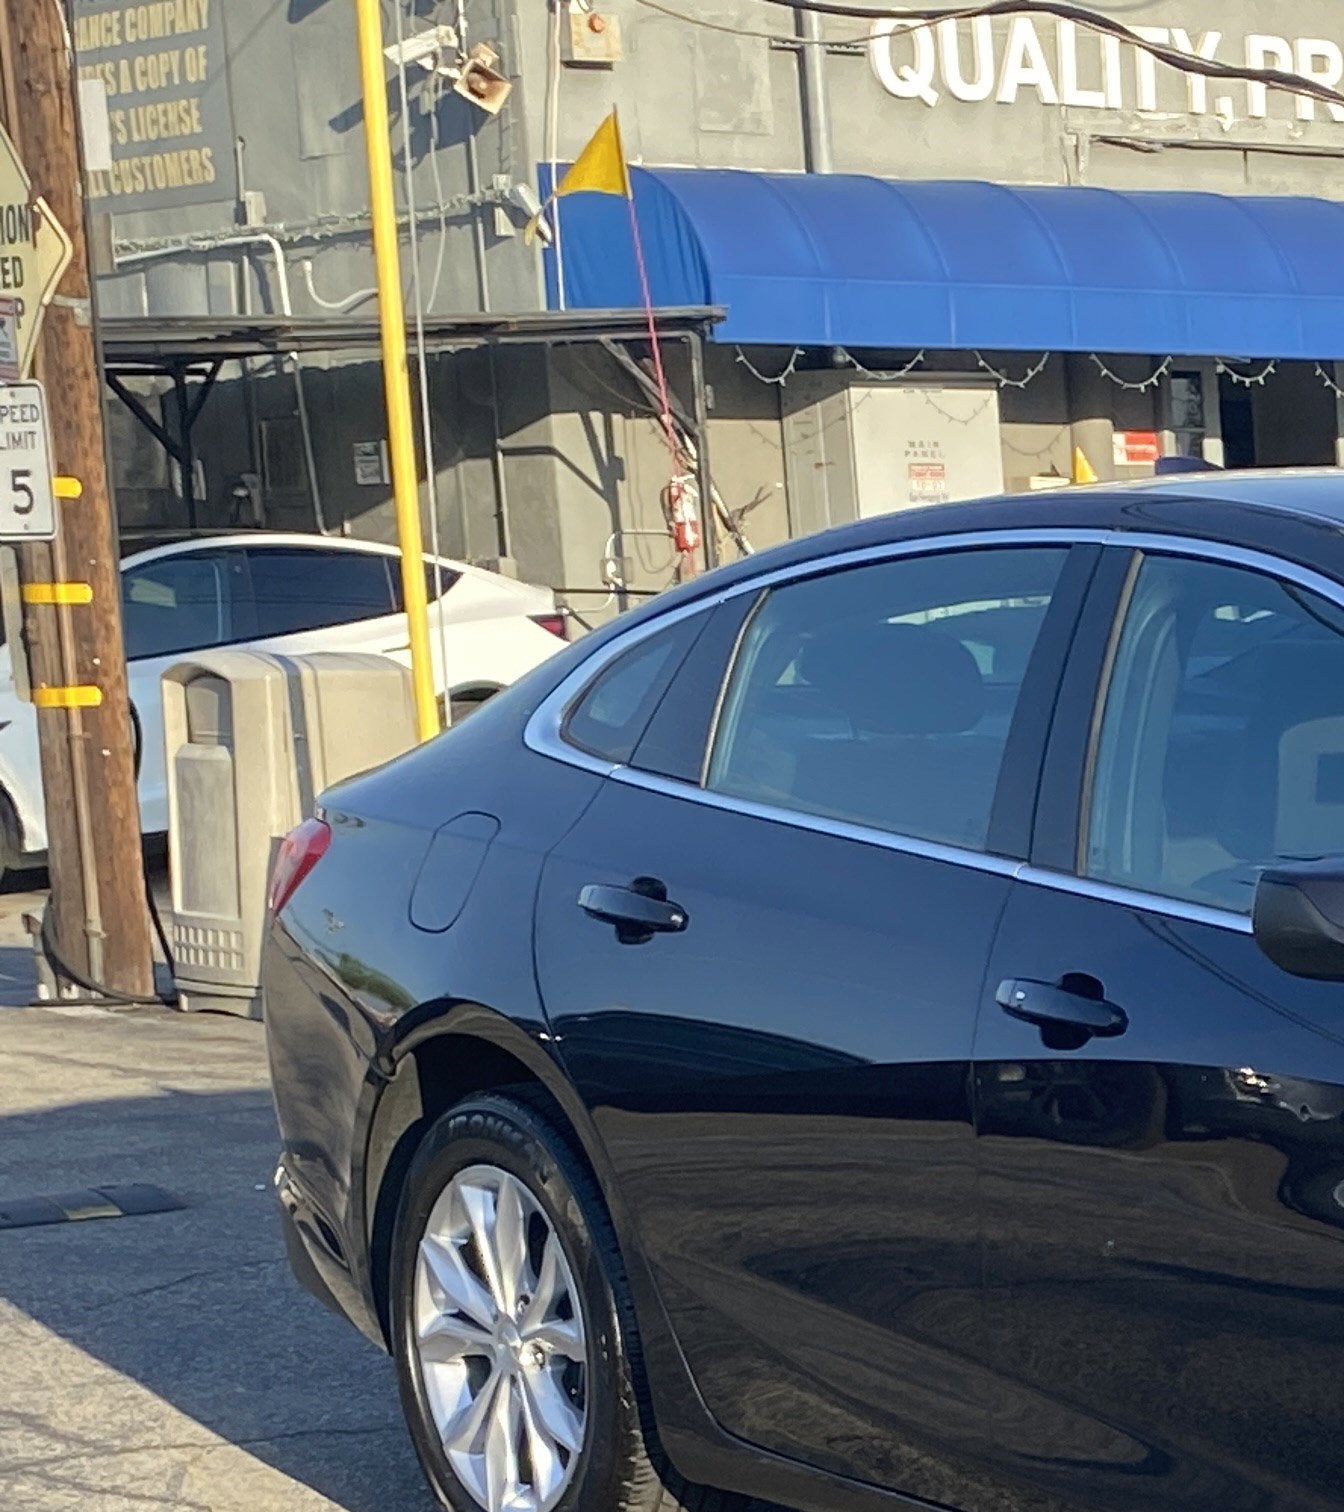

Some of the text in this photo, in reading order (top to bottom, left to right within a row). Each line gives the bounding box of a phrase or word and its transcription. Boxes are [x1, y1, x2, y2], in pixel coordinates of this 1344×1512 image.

[125, 0, 209, 43] COMPANY
[118, 59, 133, 94] A
[134, 51, 180, 92] COPY
[184, 44, 207, 83] OF
[130, 98, 203, 142] LICENSE
[109, 146, 216, 196] CUSTOMERS
[0, 256, 24, 288] ED
[0, 404, 40, 424] PEED
